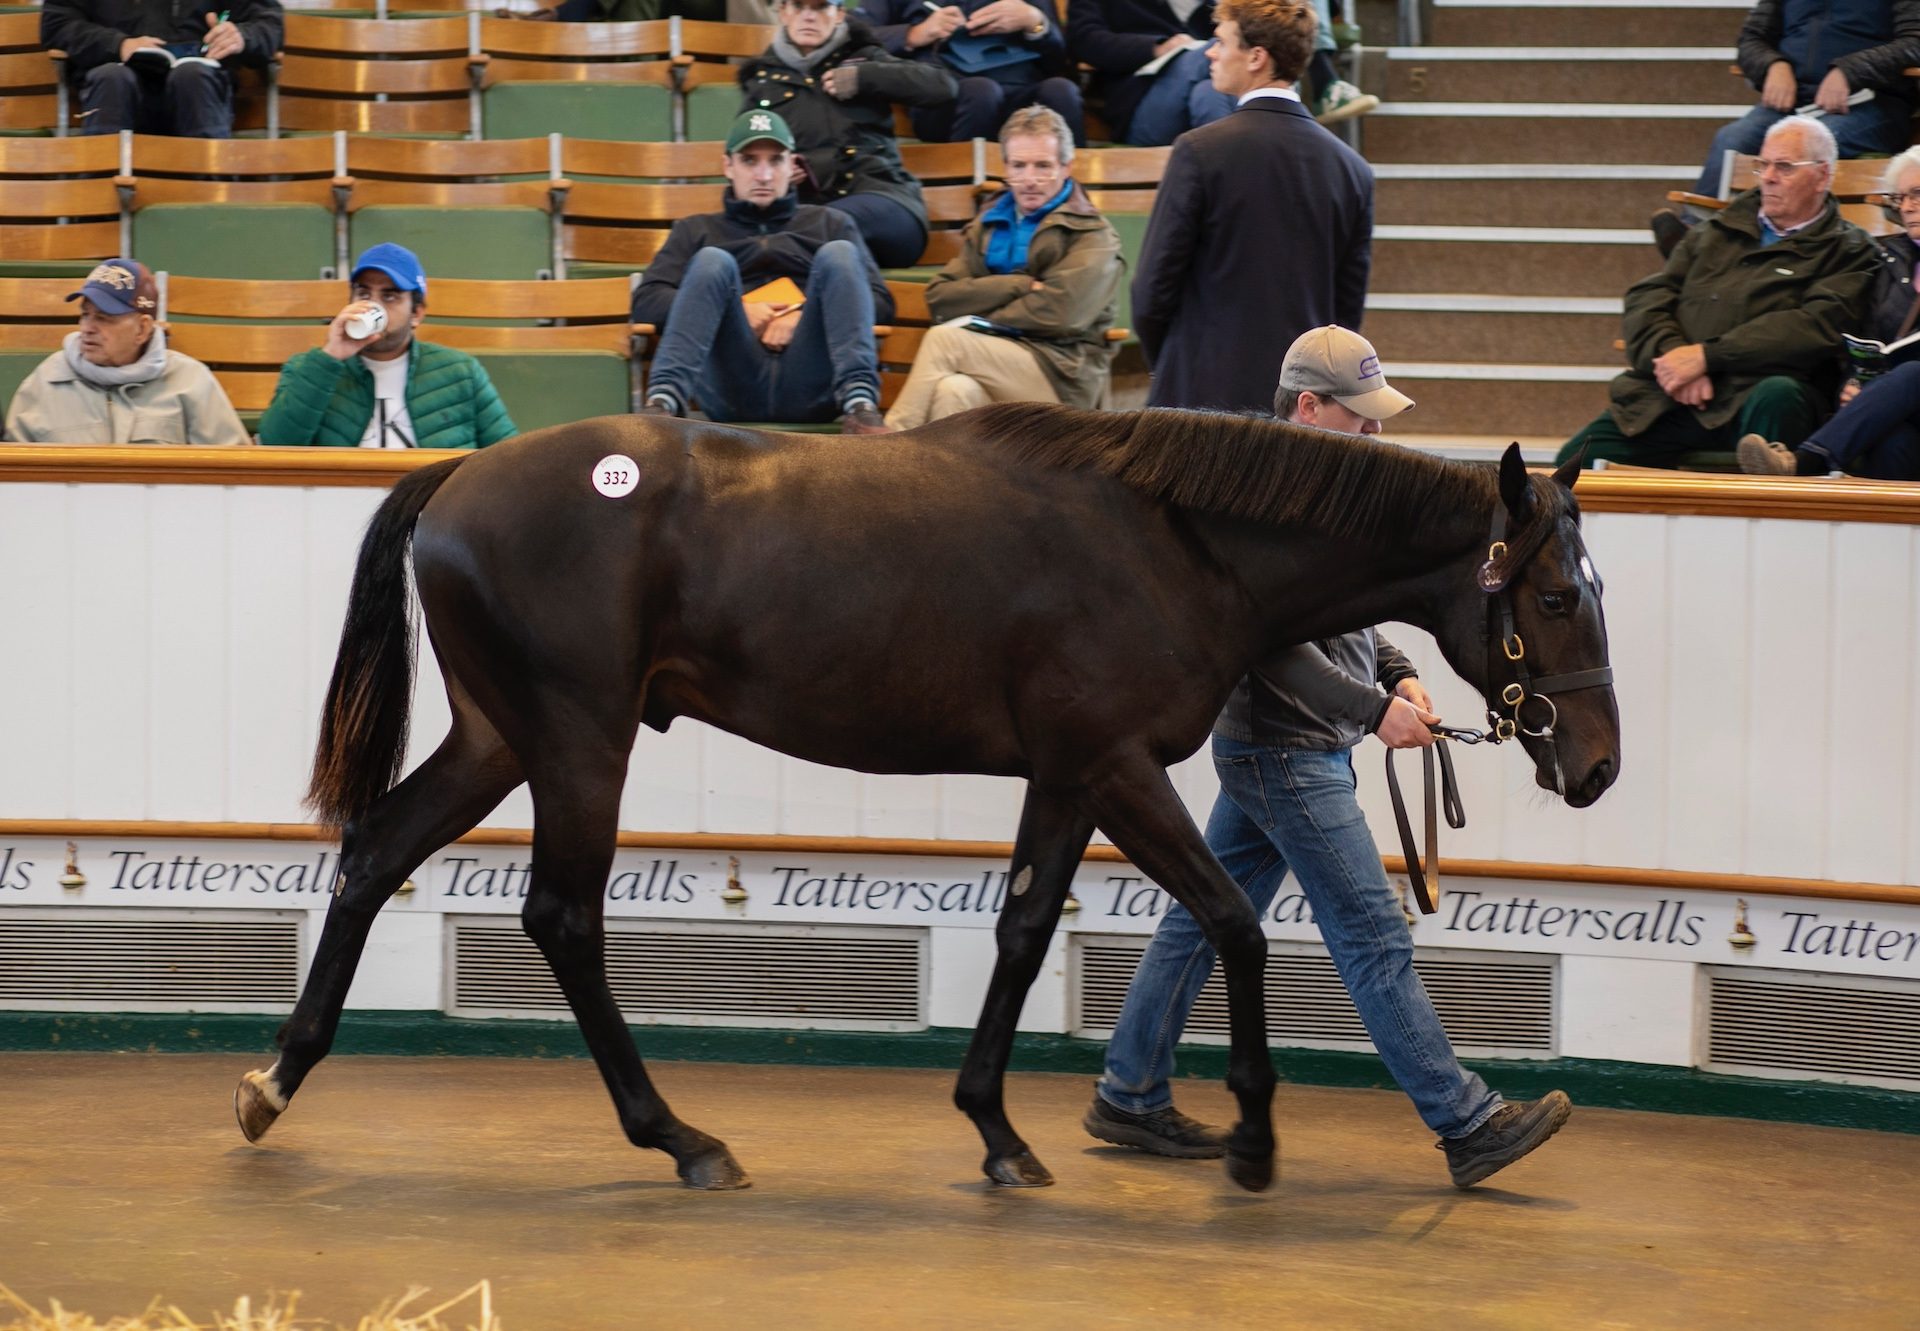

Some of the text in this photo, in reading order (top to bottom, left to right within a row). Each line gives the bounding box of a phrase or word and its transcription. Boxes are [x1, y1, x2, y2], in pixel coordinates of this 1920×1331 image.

[603, 471, 628, 485] 332
[109, 850, 341, 893] Tattersall
[442, 857, 698, 903] Tattalls
[771, 866, 1009, 913] Tattersall
[1444, 890, 1706, 946] Tattersalls
